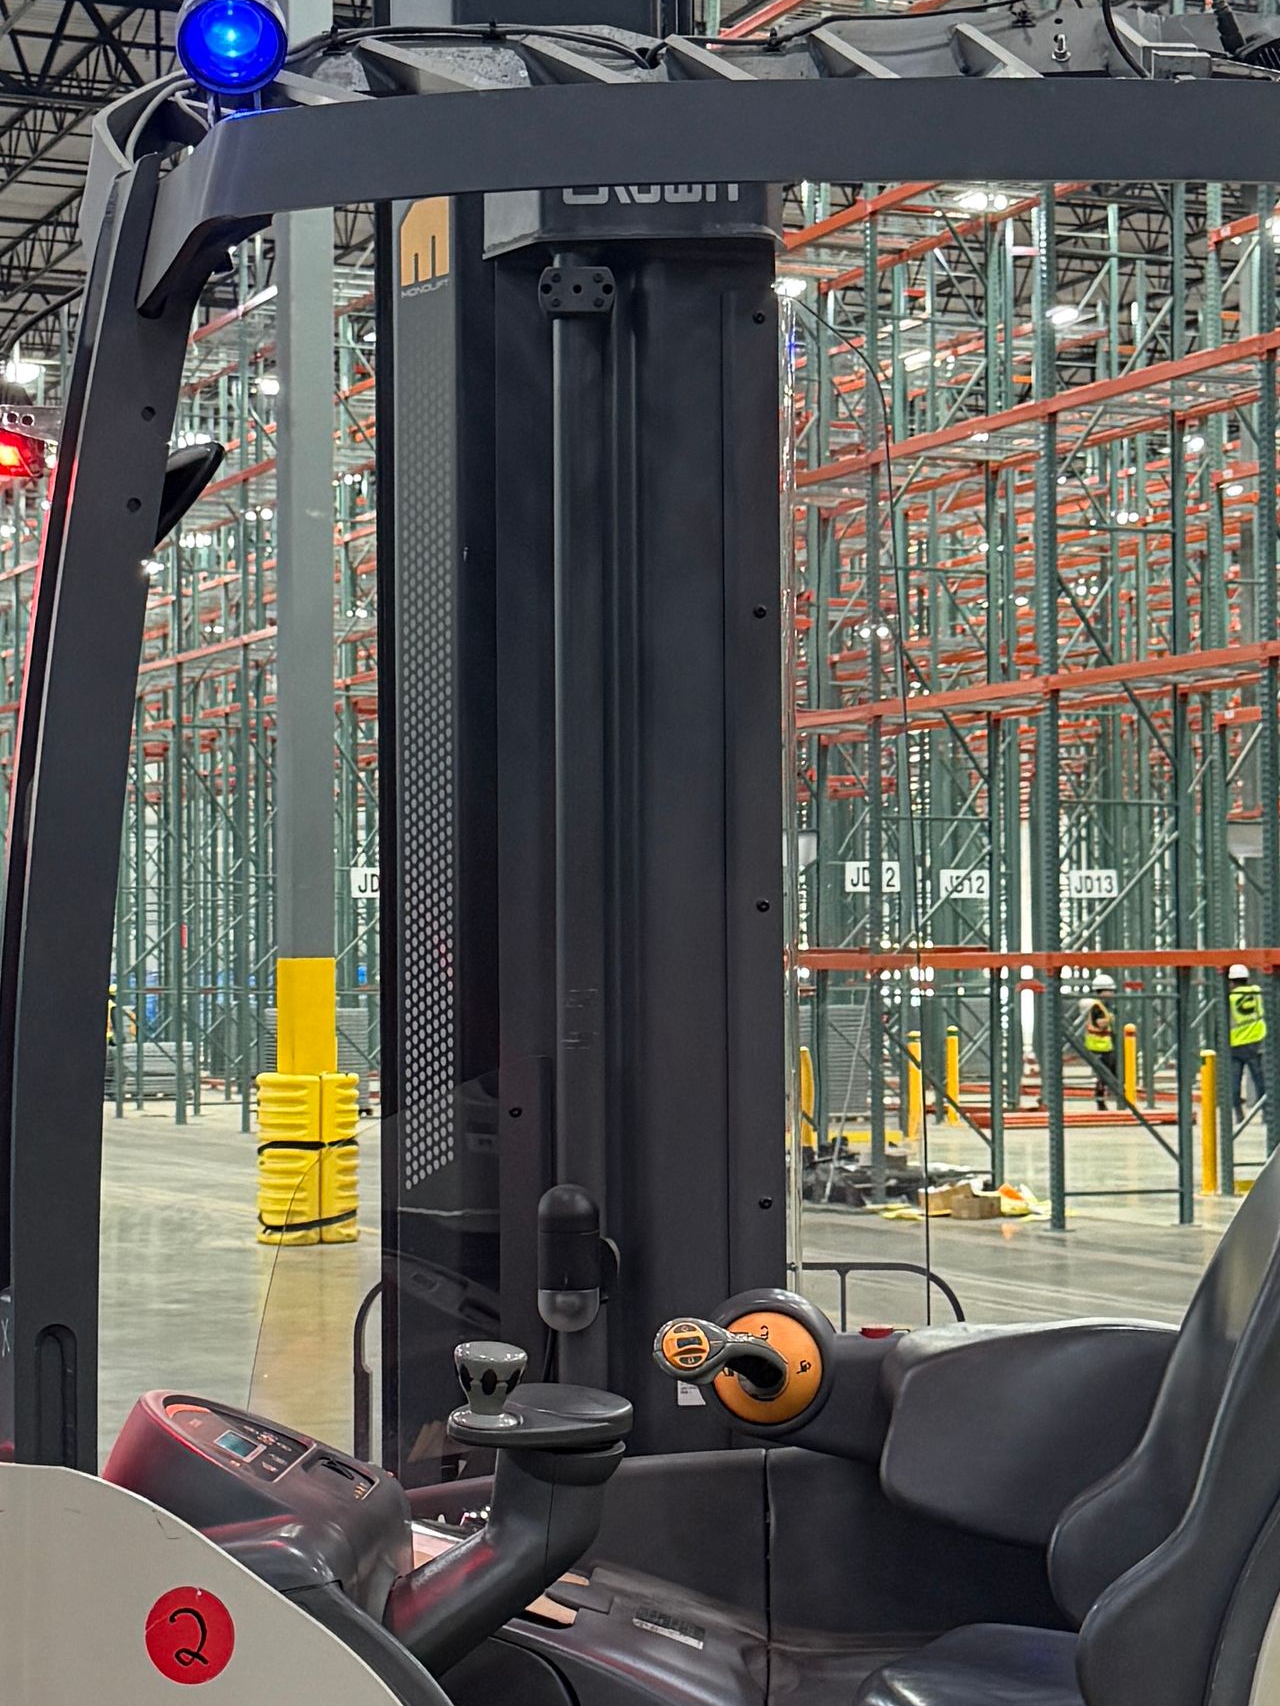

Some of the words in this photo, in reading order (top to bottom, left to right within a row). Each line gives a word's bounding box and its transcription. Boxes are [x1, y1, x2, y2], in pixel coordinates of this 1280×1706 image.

[851, 866, 896, 888] JD2
[1074, 875, 1114, 894] JD13
[169, 1607, 209, 1667] 2
